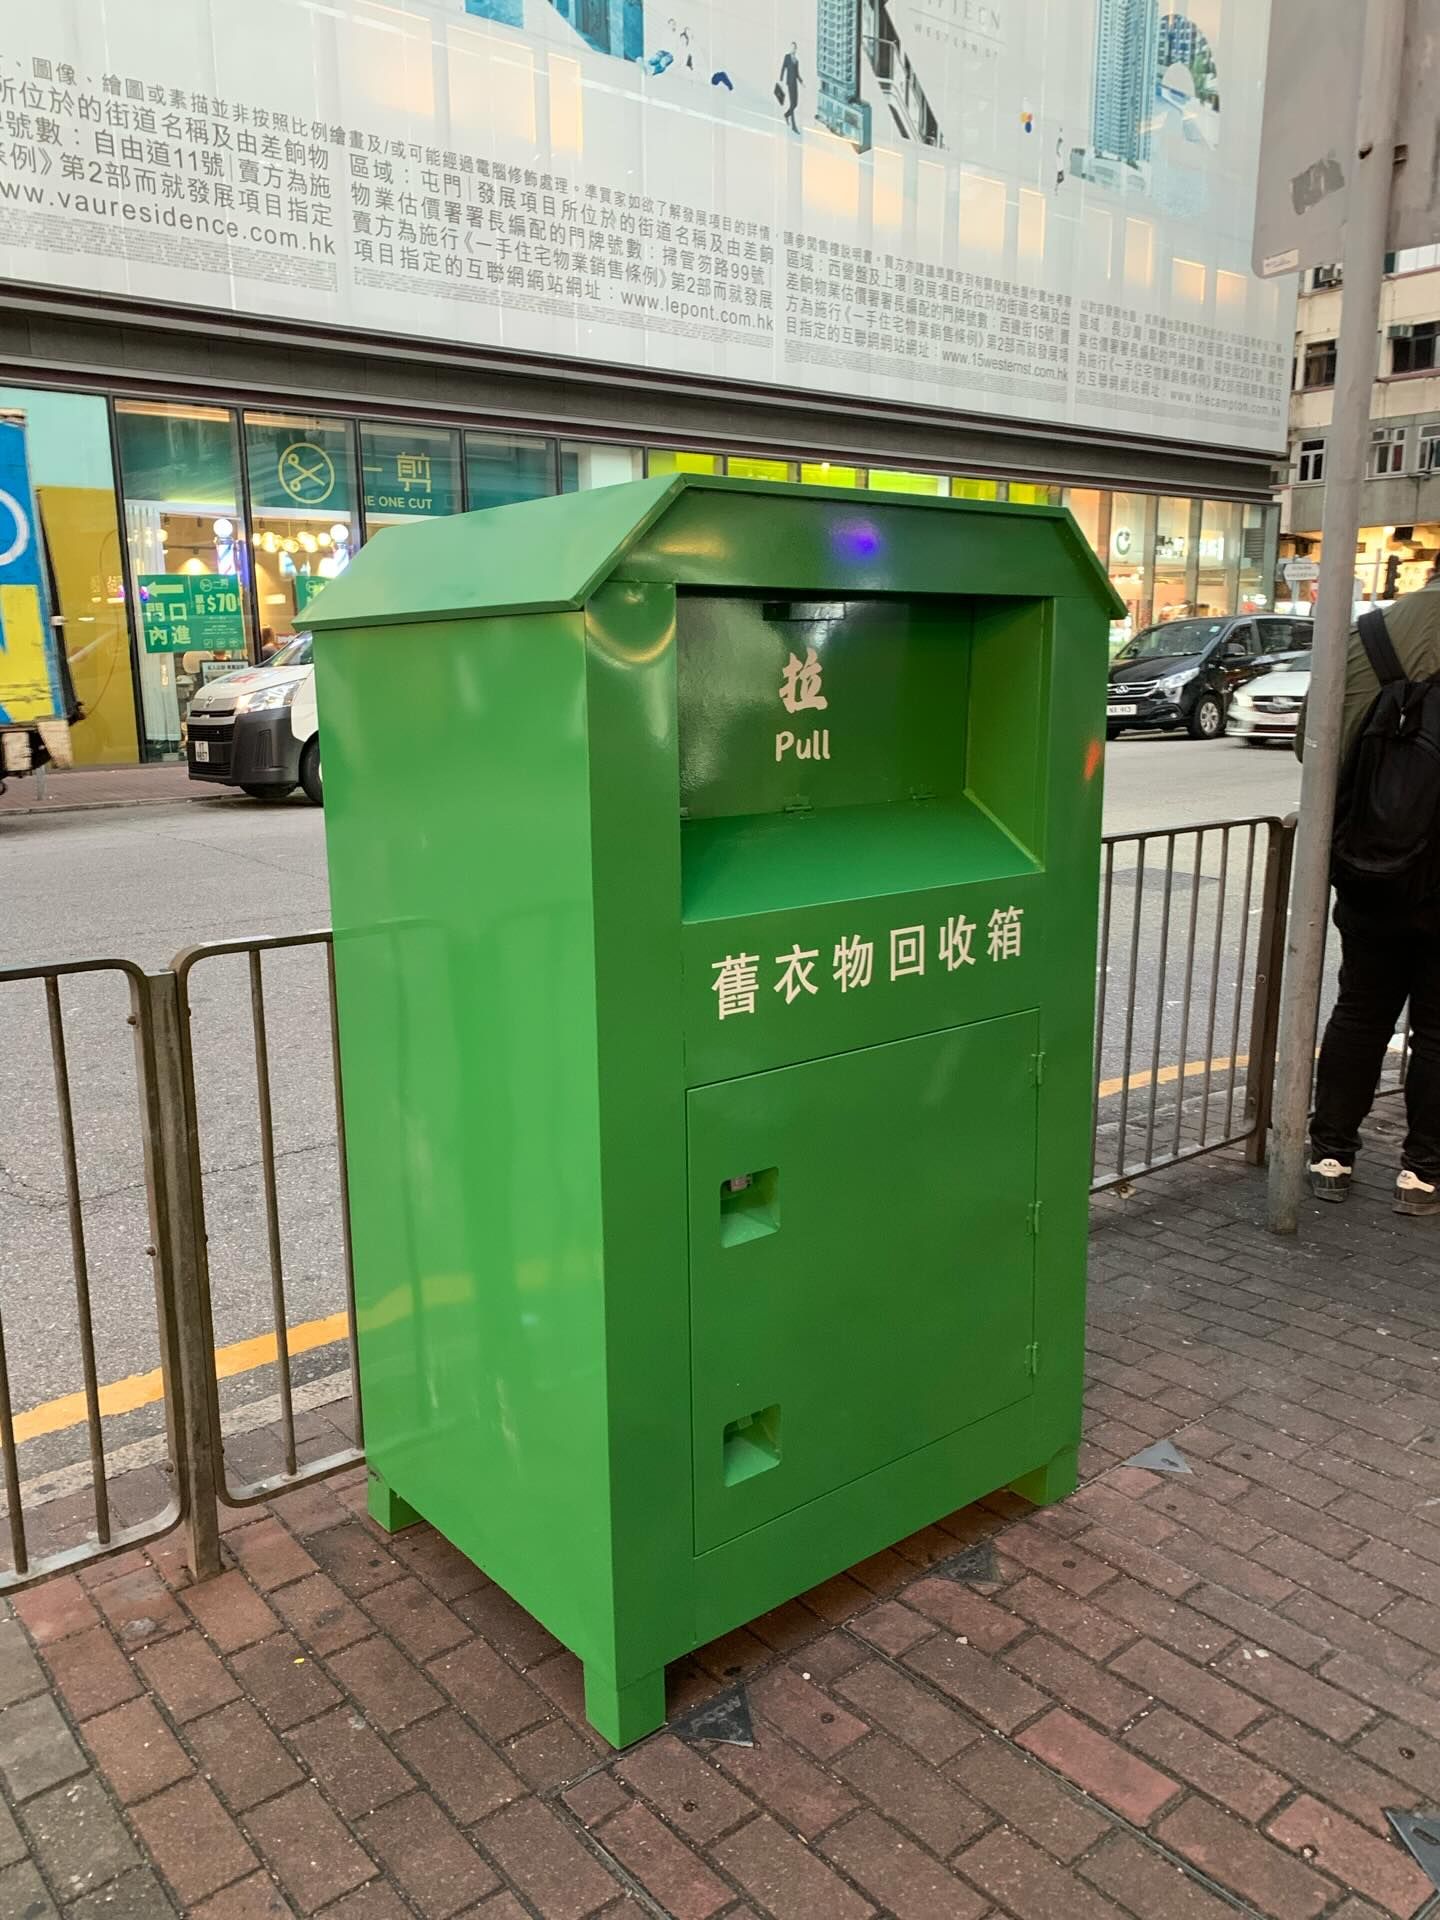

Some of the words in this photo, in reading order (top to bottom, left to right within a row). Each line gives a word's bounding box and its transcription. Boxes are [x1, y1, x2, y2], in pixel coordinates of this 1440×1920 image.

[378, 496, 405, 508] ONE
[408, 498, 433, 510] CUT
[145, 602, 188, 623] 門口
[778, 647, 829, 714] 拉
[775, 729, 831, 762] Pull
[711, 904, 1024, 1021] 舊衣物回收箱
